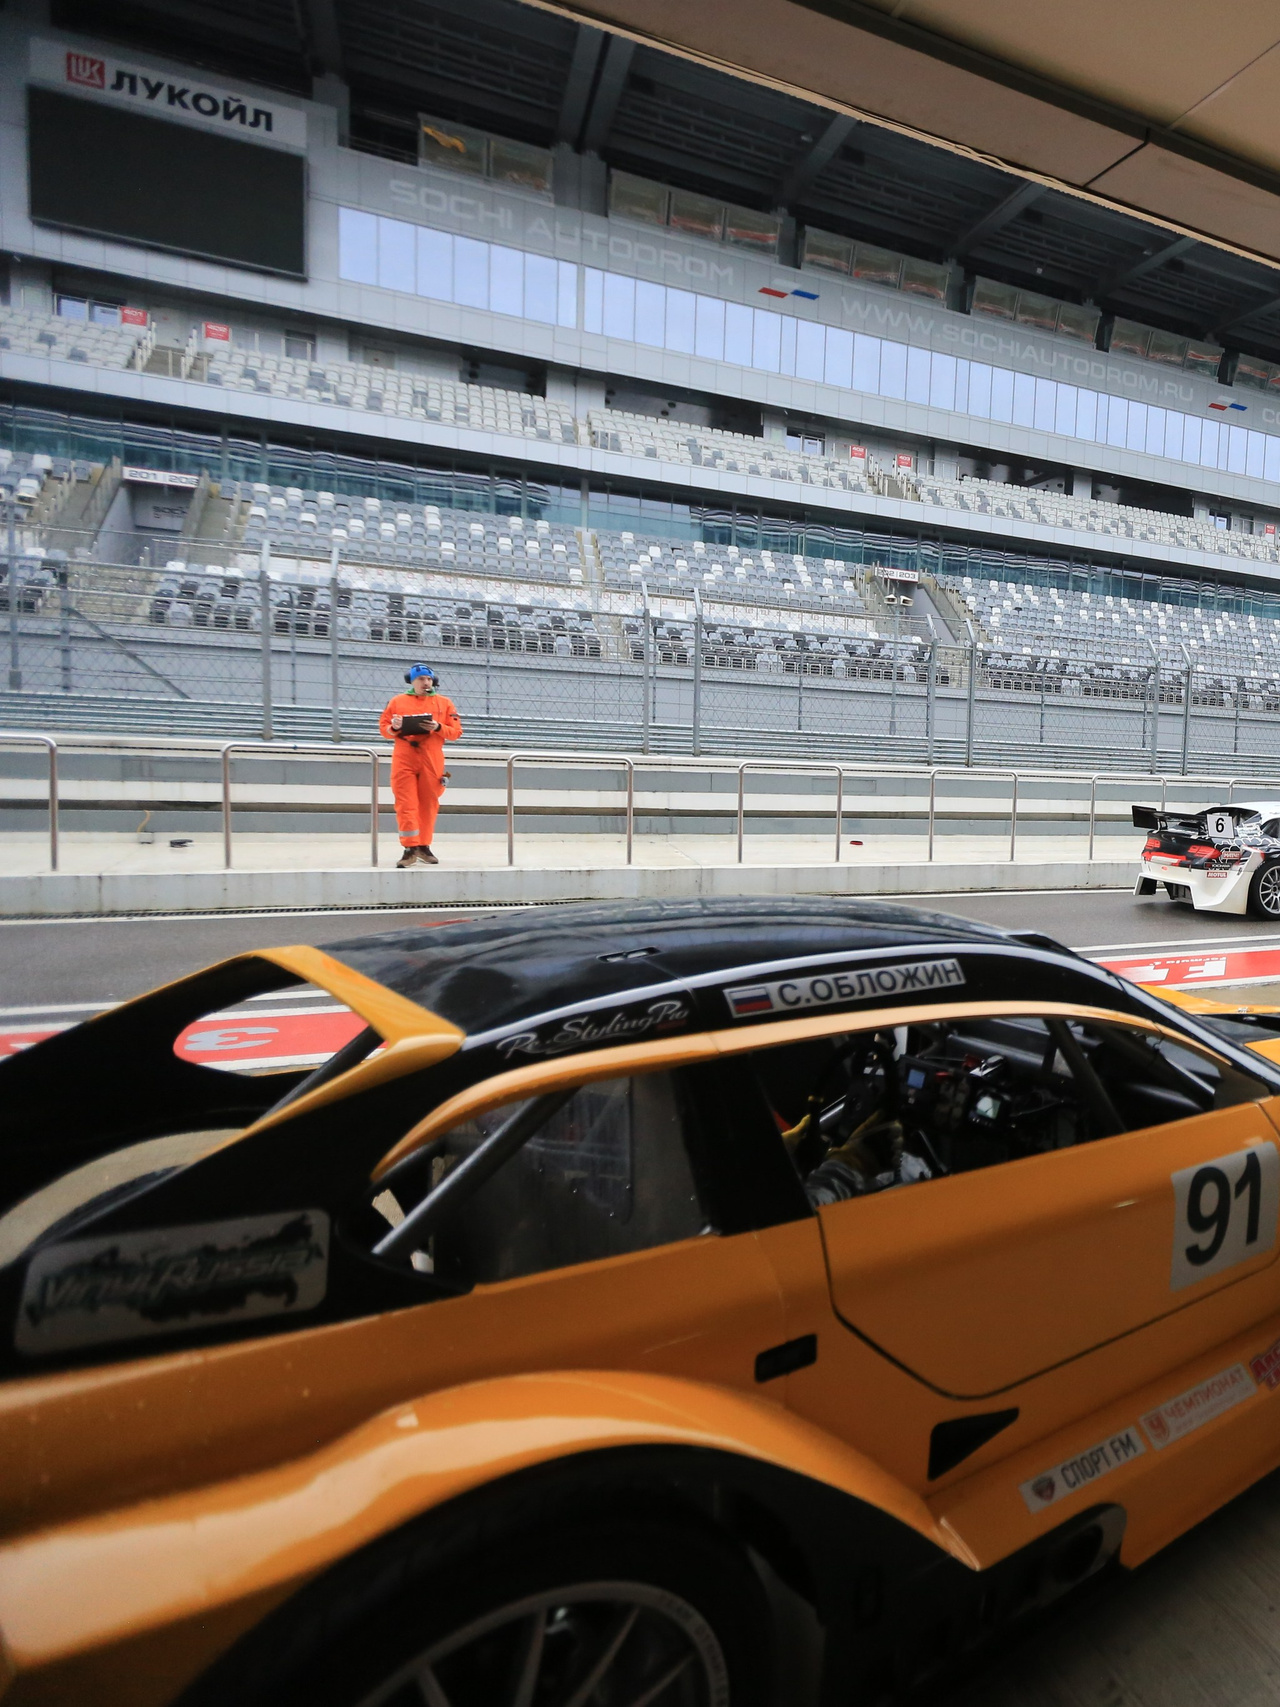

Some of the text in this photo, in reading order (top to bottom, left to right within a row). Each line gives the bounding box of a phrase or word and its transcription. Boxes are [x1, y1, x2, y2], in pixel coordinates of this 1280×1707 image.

[110, 70, 273, 132] ЛУКОЙЛ
[389, 178, 734, 285] SOCHI AUTODROM
[840, 296, 1194, 402] WWW.SOCHIAUTODROM.RU
[1215, 817, 1225, 833] 6
[777, 961, 965, 1007] С.ОБЛОЖИН
[1185, 1152, 1262, 1267] 91
[1165, 1366, 1245, 1420] ЧЕМПИОНАТ
[1060, 1432, 1138, 1489] СПОРТ FM
